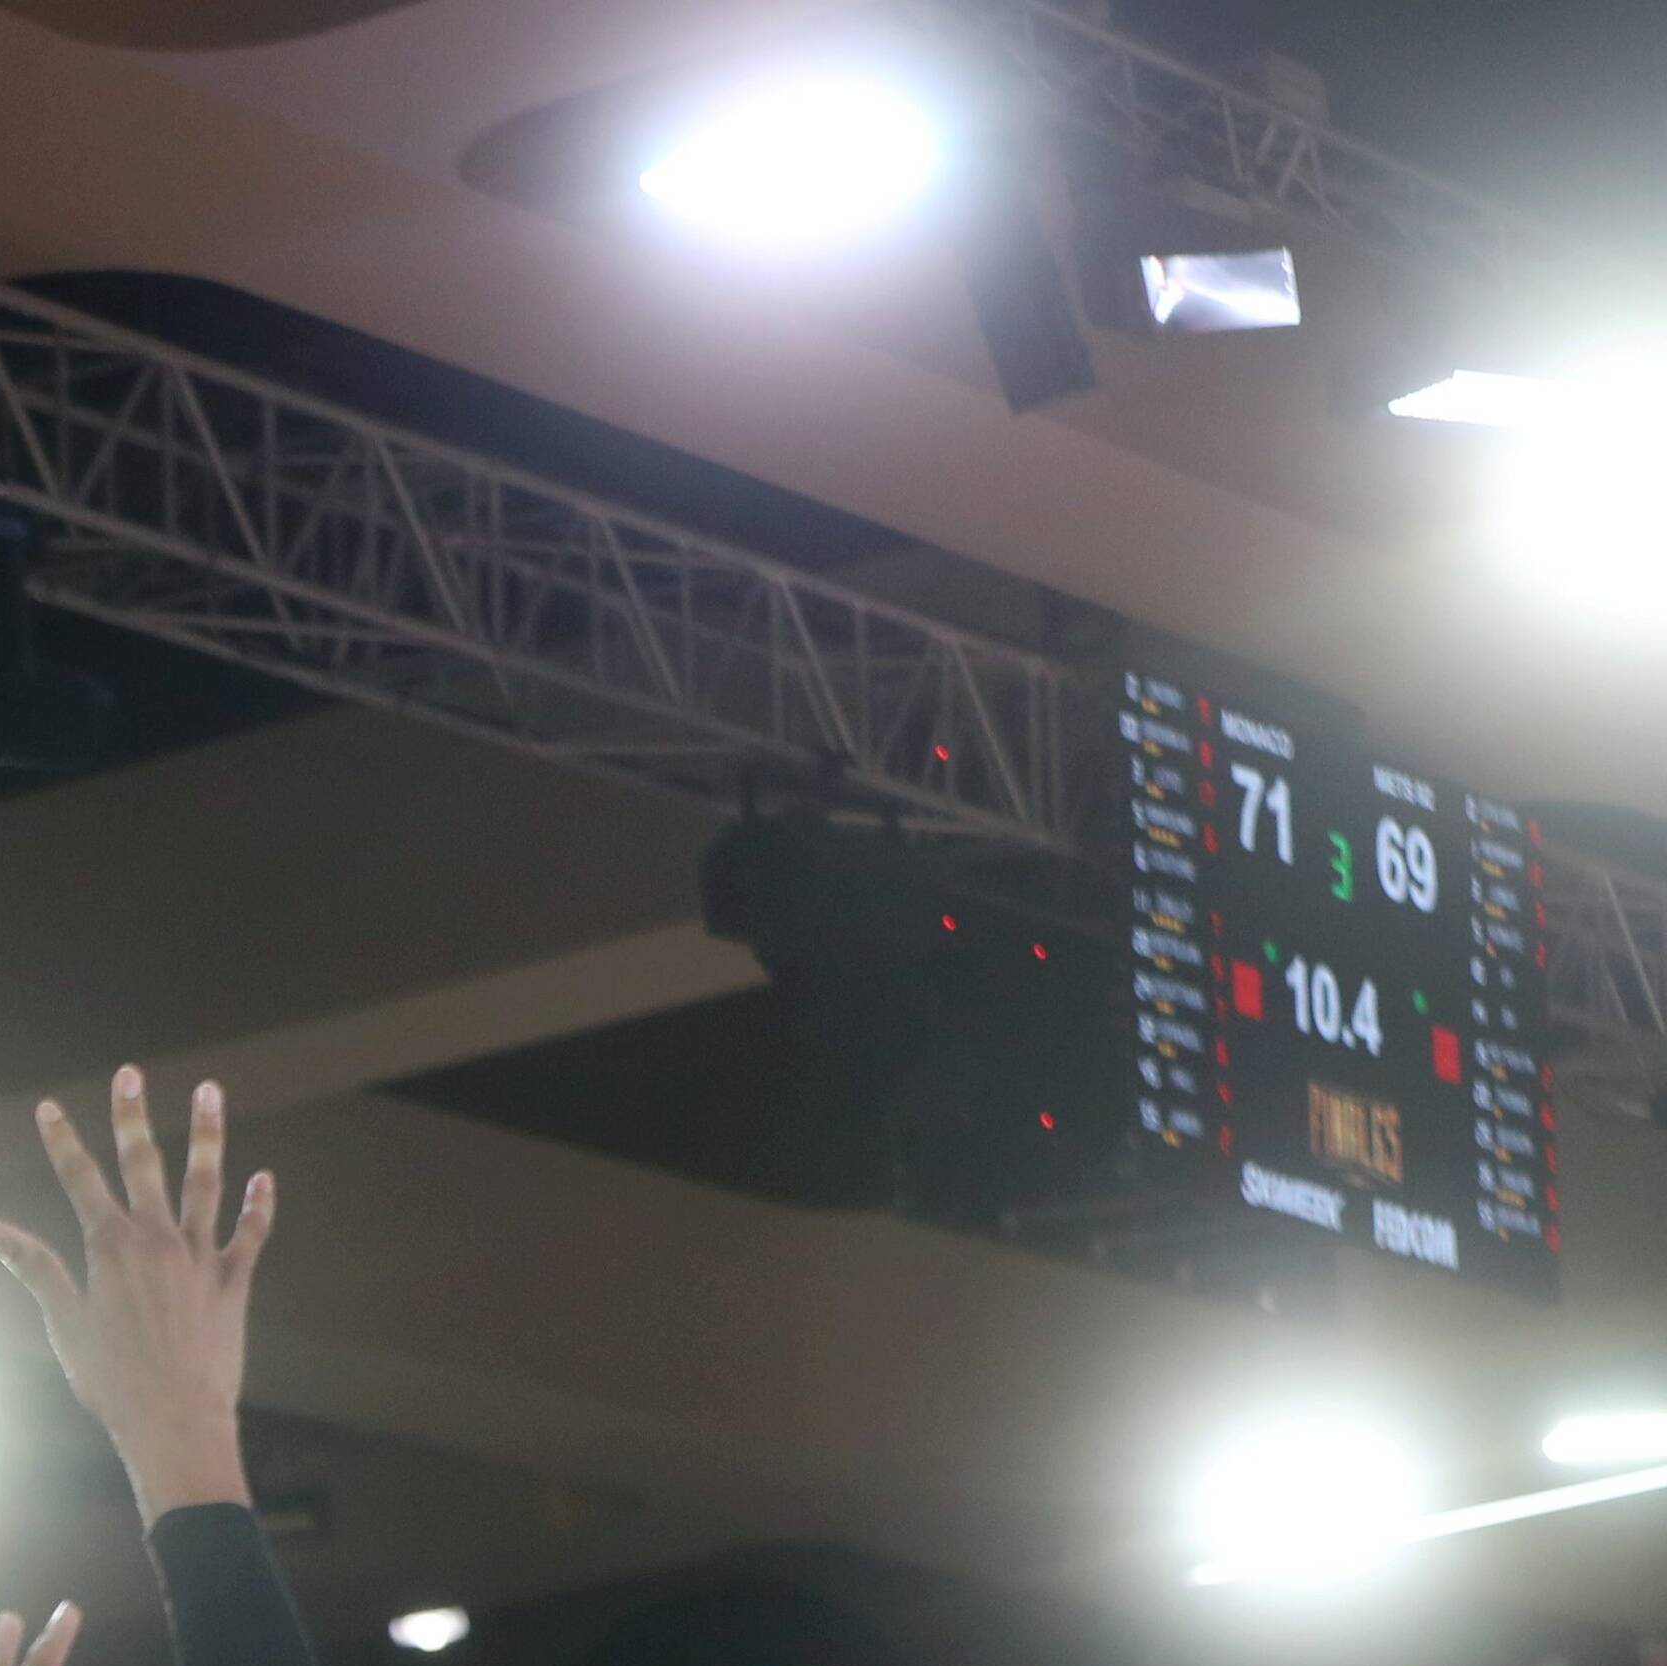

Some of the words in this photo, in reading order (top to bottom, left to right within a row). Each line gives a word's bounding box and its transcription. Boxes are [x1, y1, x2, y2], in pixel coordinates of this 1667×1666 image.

[1230, 762, 1294, 867] 71
[1375, 815, 1437, 913] 69
[1327, 829, 1354, 902] 3
[1285, 954, 1385, 1058] 10.4
